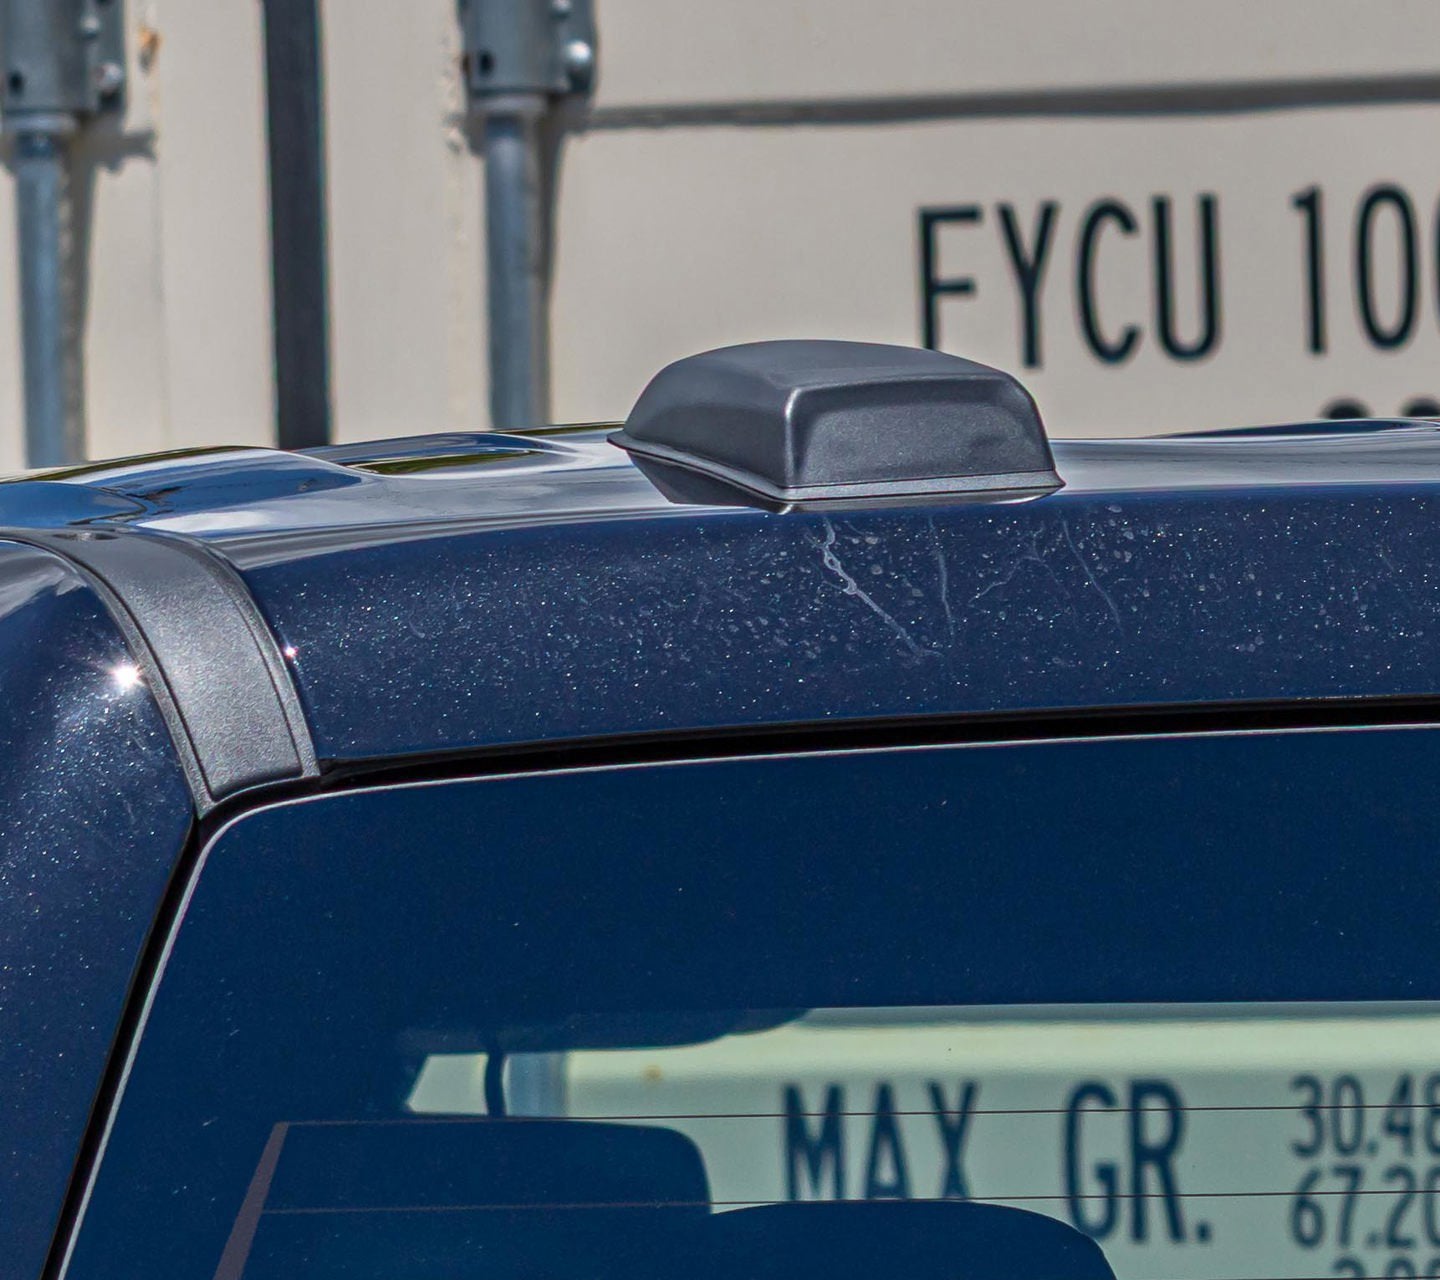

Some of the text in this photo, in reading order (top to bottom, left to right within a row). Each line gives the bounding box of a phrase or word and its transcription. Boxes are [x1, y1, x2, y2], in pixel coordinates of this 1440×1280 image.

[917, 190, 1221, 369] FYCU
[781, 1080, 977, 1202] MAX
[1063, 1077, 1213, 1244] GR.
